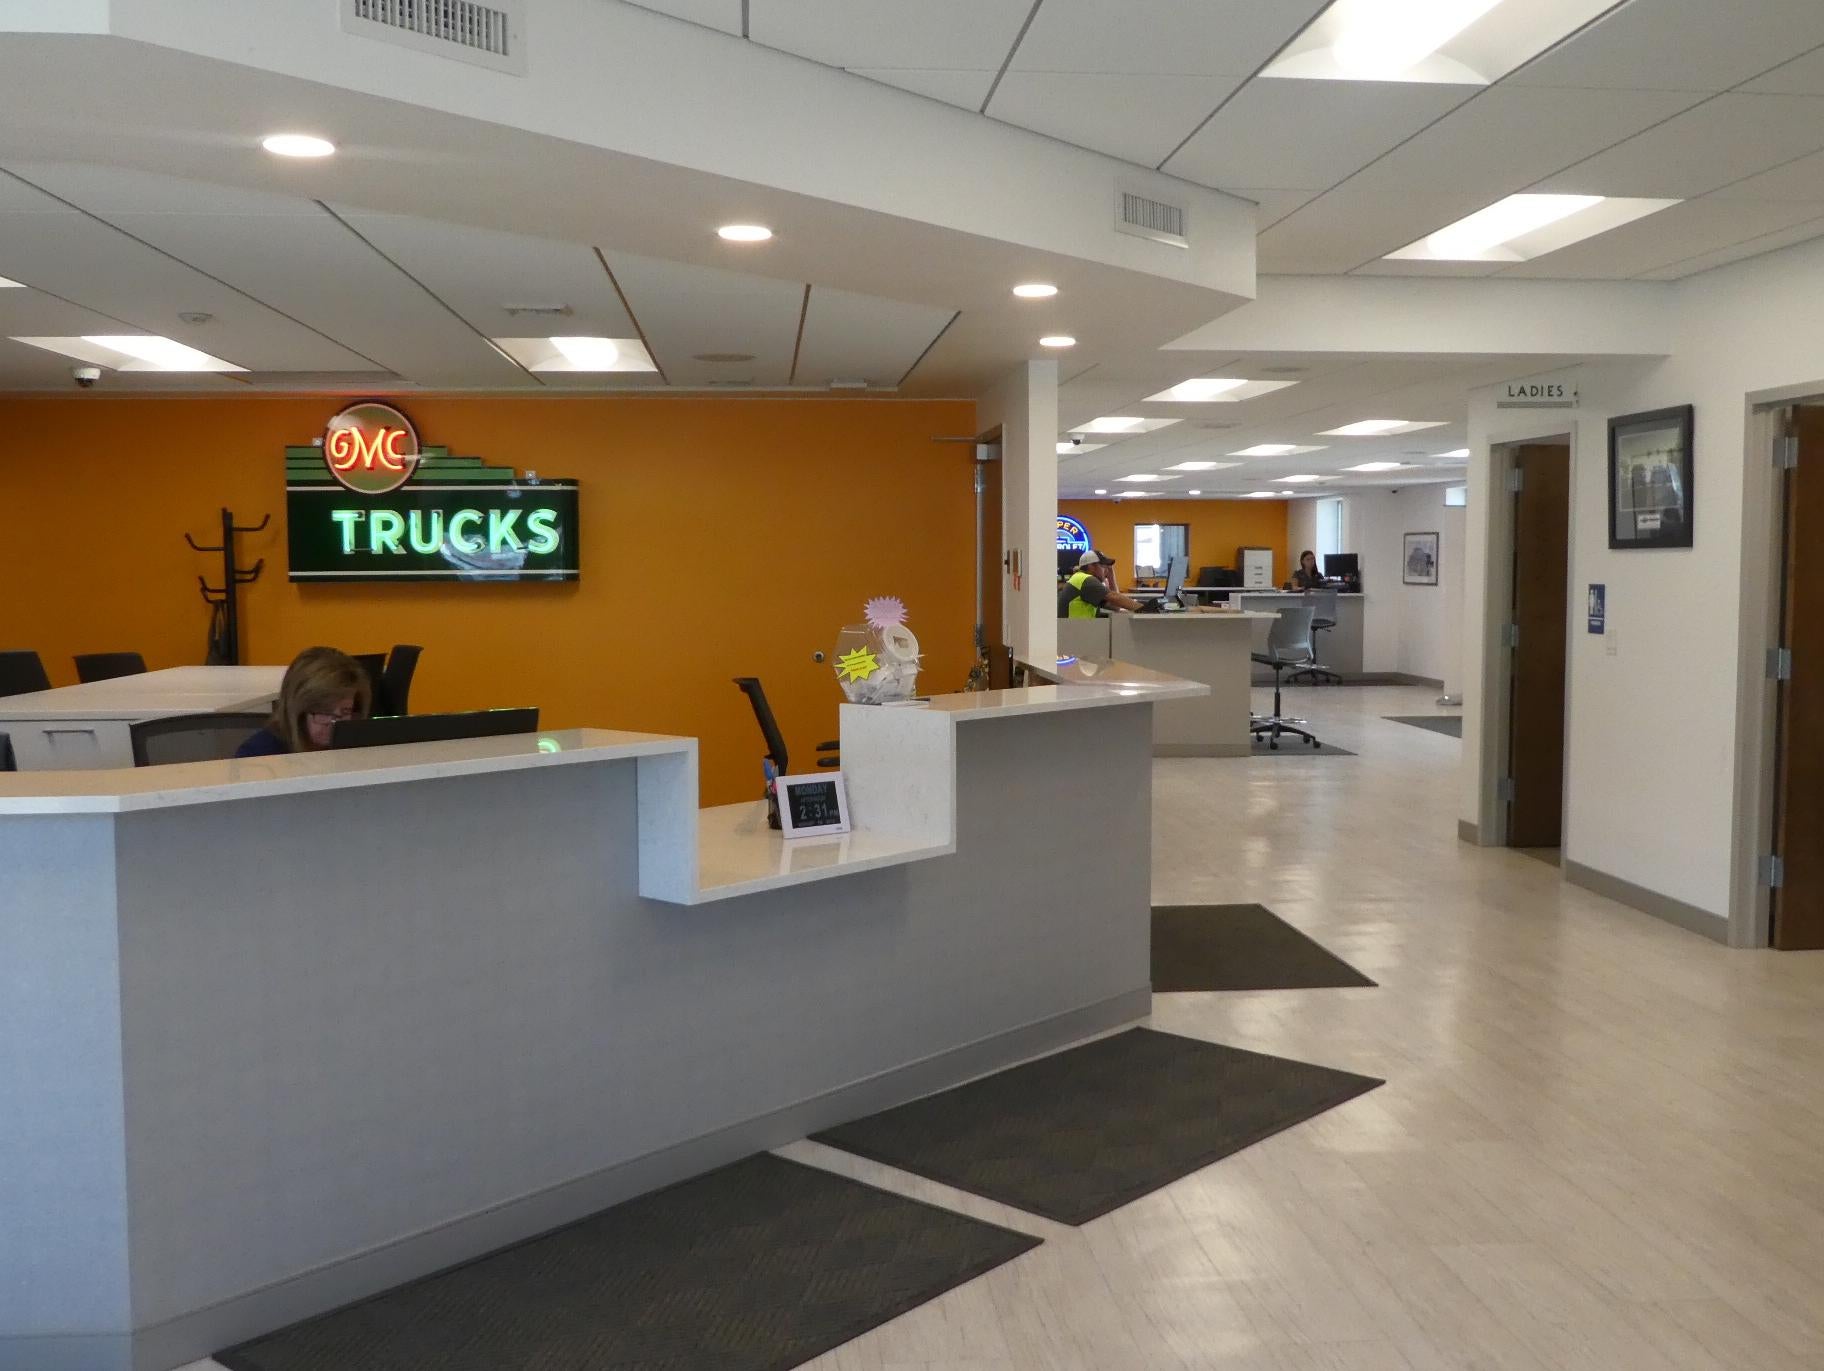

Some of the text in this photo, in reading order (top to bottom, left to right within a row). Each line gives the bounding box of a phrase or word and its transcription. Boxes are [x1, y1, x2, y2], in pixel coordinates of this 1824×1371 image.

[1507, 384, 1564, 398] LADIES
[329, 425, 407, 470] GMC
[331, 508, 560, 555] TRUCKS
[1056, 521, 1078, 534] PER
[795, 783, 827, 795] MONDAY
